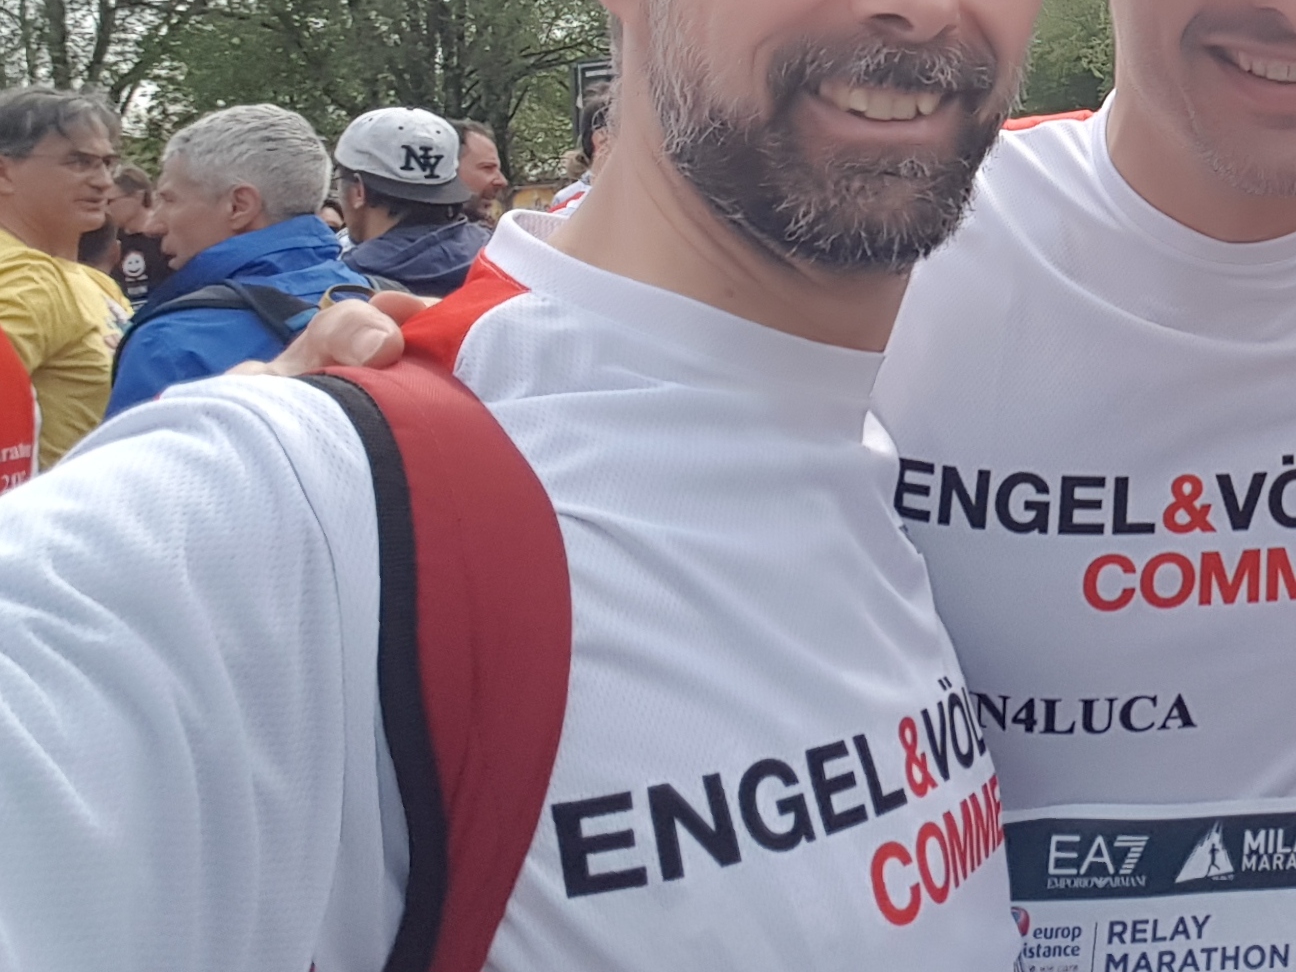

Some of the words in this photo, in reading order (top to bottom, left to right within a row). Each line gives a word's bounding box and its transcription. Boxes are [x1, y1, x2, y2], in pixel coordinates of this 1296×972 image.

[401, 144, 445, 179] NY
[1047, 834, 1150, 876] EA7
[1033, 926, 1082, 942] europ
[1107, 915, 1211, 945] RELAY
[1104, 944, 1290, 972] MARATHON
